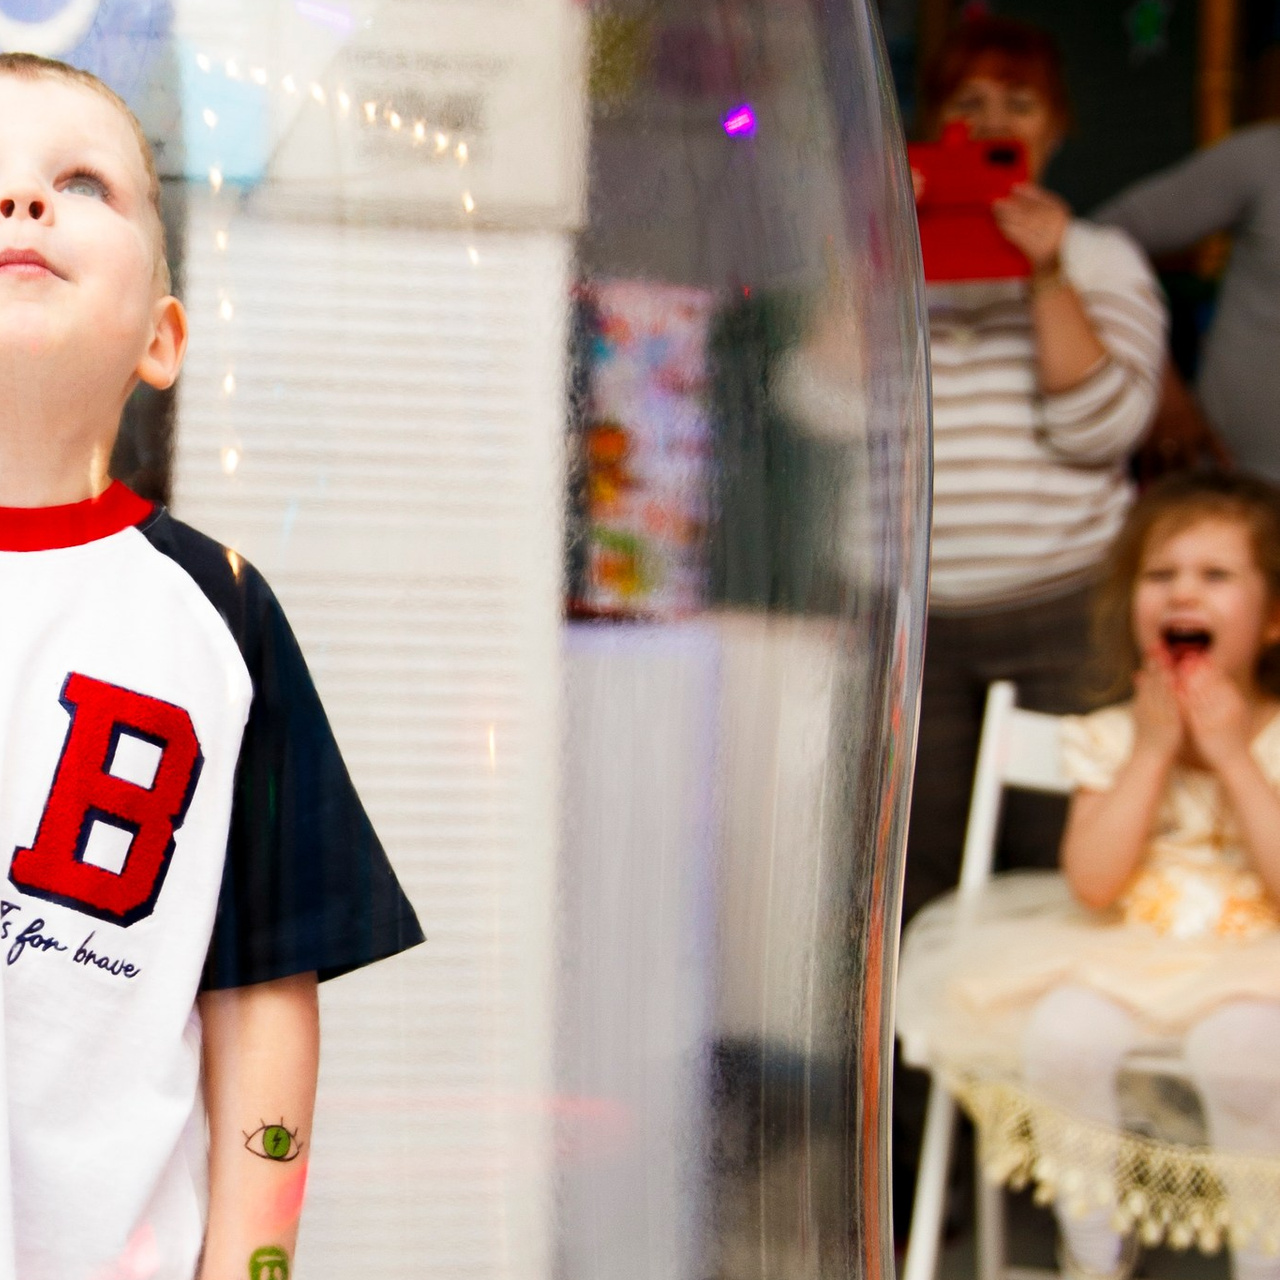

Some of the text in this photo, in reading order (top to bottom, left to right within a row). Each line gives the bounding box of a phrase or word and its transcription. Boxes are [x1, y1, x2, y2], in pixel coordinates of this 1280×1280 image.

[7, 670, 206, 929] B
[6, 917, 69, 966] for
[72, 929, 141, 979] brave
